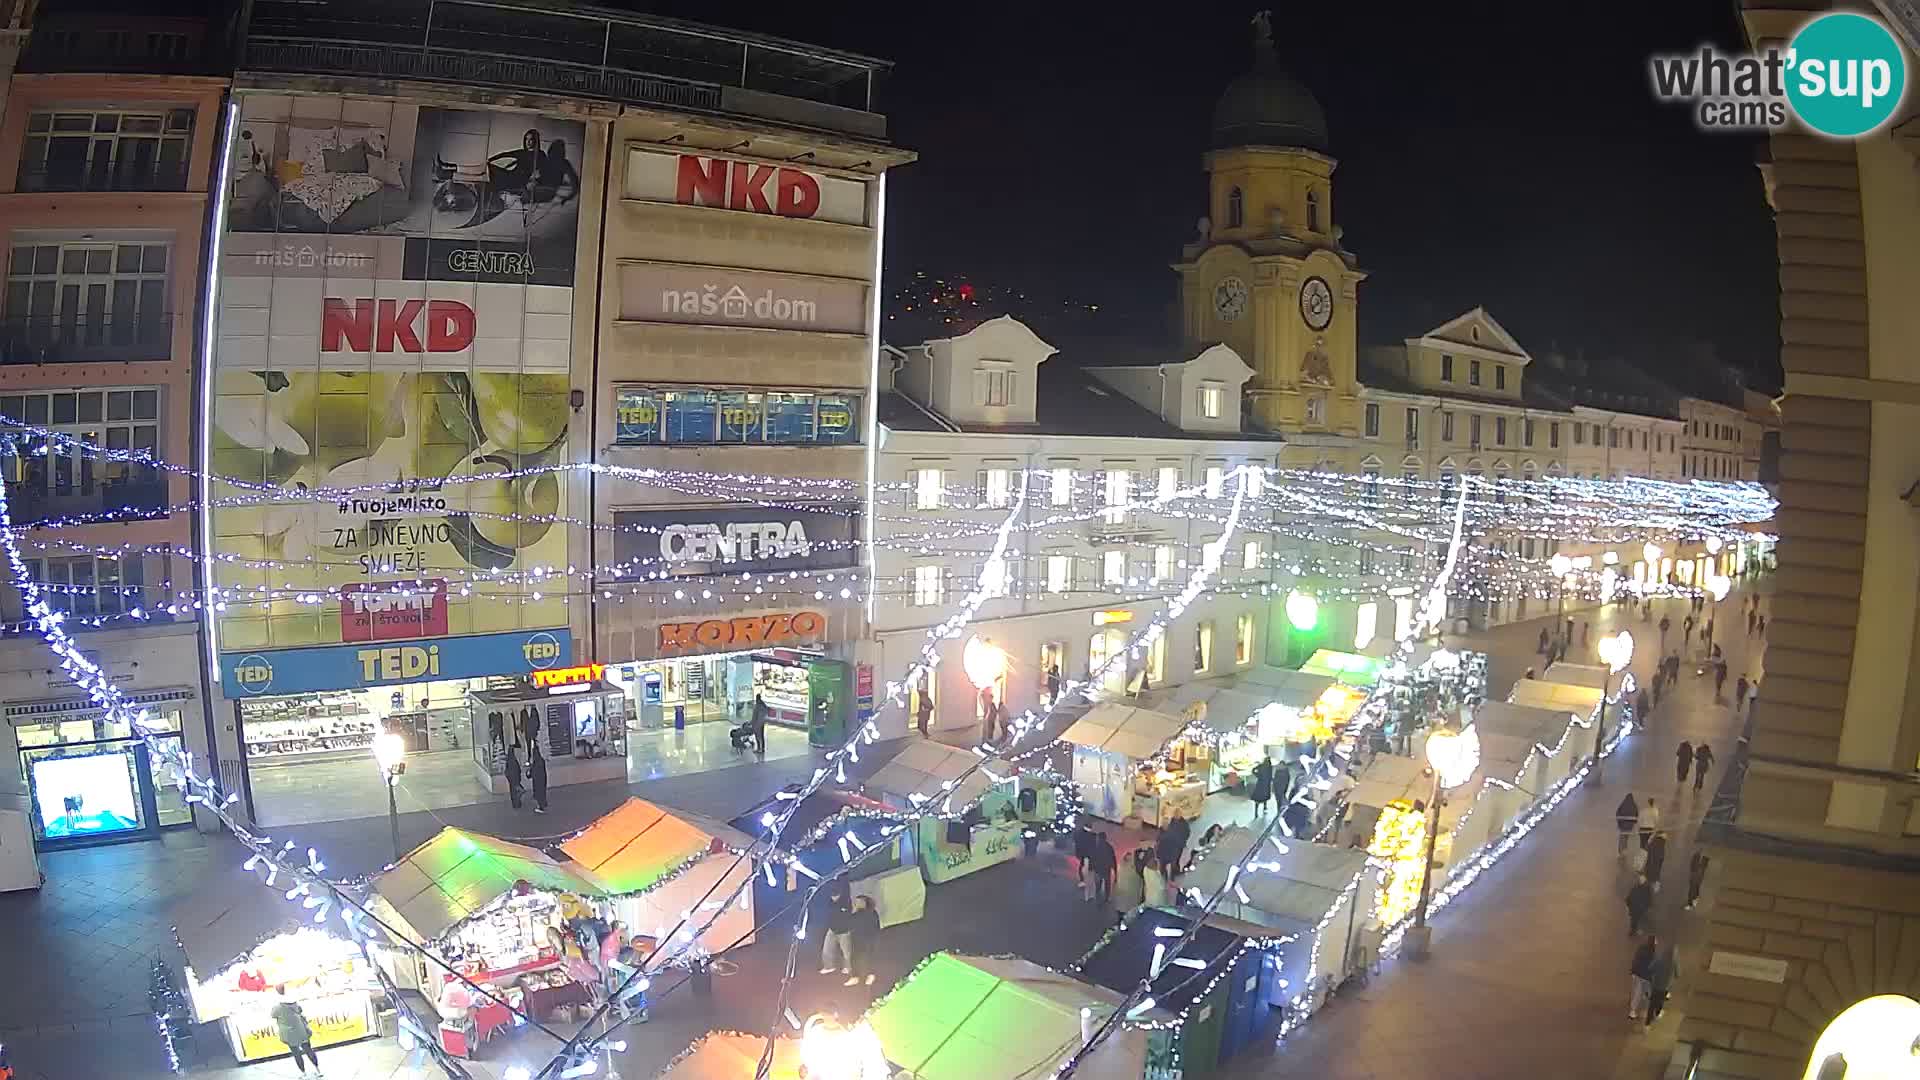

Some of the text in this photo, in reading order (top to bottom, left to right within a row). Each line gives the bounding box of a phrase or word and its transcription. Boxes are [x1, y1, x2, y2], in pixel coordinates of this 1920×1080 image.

[676, 154, 821, 218] NKD
[448, 249, 535, 276] CENTRA
[661, 284, 817, 322] naš dom
[321, 297, 477, 353] NKD
[338, 496, 447, 515] #TvojeMisto
[333, 522, 451, 548] ZA DNEVNO
[660, 520, 811, 563] CENTRA
[359, 547, 426, 575] SVJEŽE
[659, 611, 826, 649] KORZO
[358, 643, 440, 682] TEDi
[522, 642, 560, 660] TEDi
[234, 664, 273, 684] TEDi
